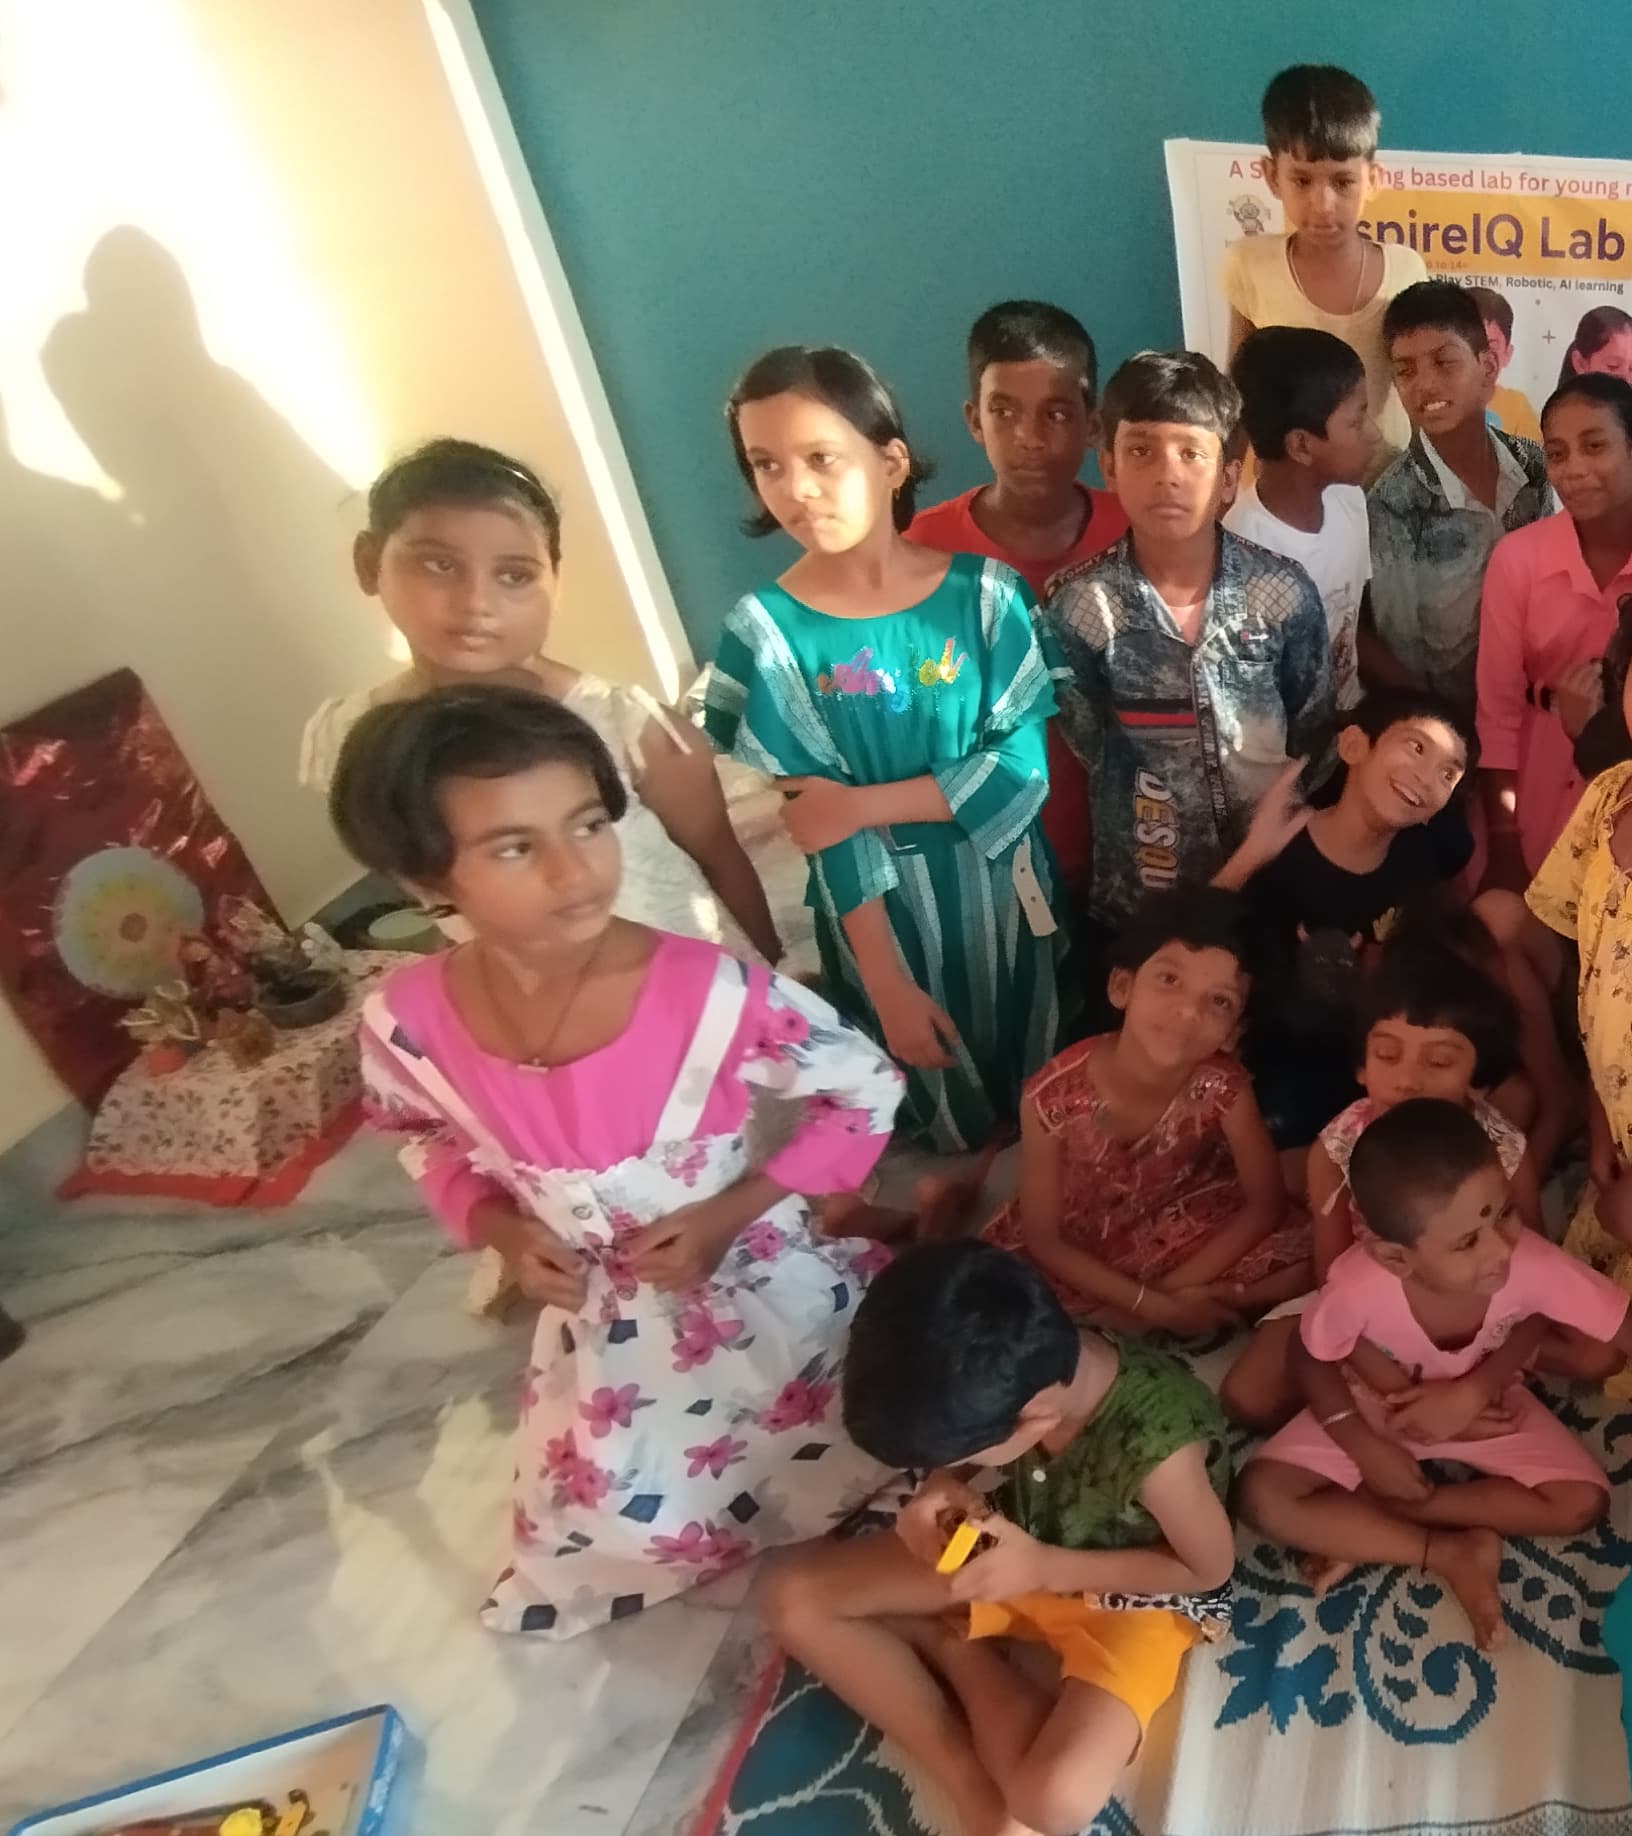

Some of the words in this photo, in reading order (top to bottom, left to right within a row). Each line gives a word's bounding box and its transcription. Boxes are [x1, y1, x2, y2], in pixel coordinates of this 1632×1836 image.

[1229, 160, 1244, 178] A
[1411, 167, 1474, 187] based
[1480, 169, 1512, 189] lab
[1519, 171, 1548, 192] for
[1555, 178, 1619, 199] young
[1356, 208, 1524, 260] spireIQ
[1540, 216, 1625, 262] Lab
[1506, 277, 1556, 291] Robotic,
[1560, 279, 1572, 290] AI
[1575, 280, 1624, 295] learning
